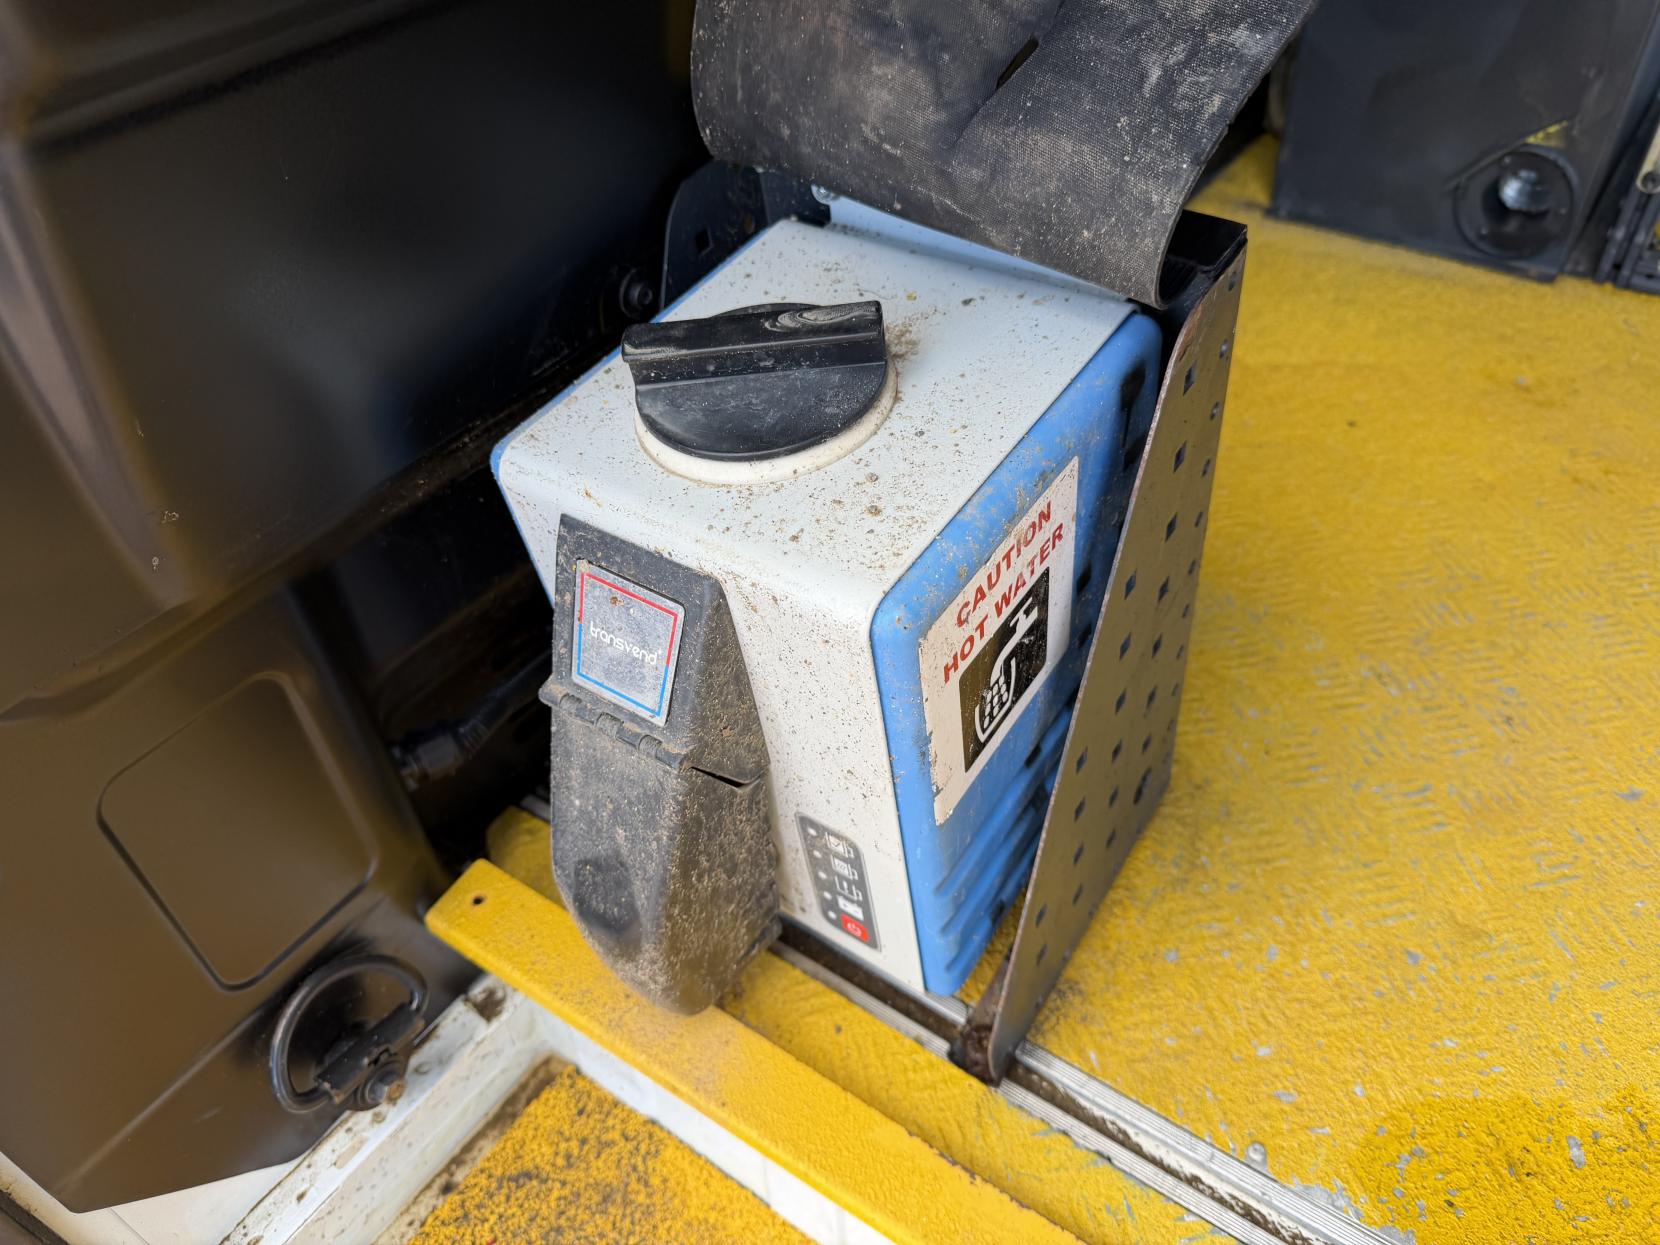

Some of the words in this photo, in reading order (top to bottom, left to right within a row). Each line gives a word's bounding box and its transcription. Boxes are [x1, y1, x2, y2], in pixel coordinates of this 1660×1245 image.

[943, 614, 989, 684] HOT
[994, 522, 1064, 619] WATER
[956, 501, 1052, 628] CAUTION
[590, 620, 658, 665] transvend
